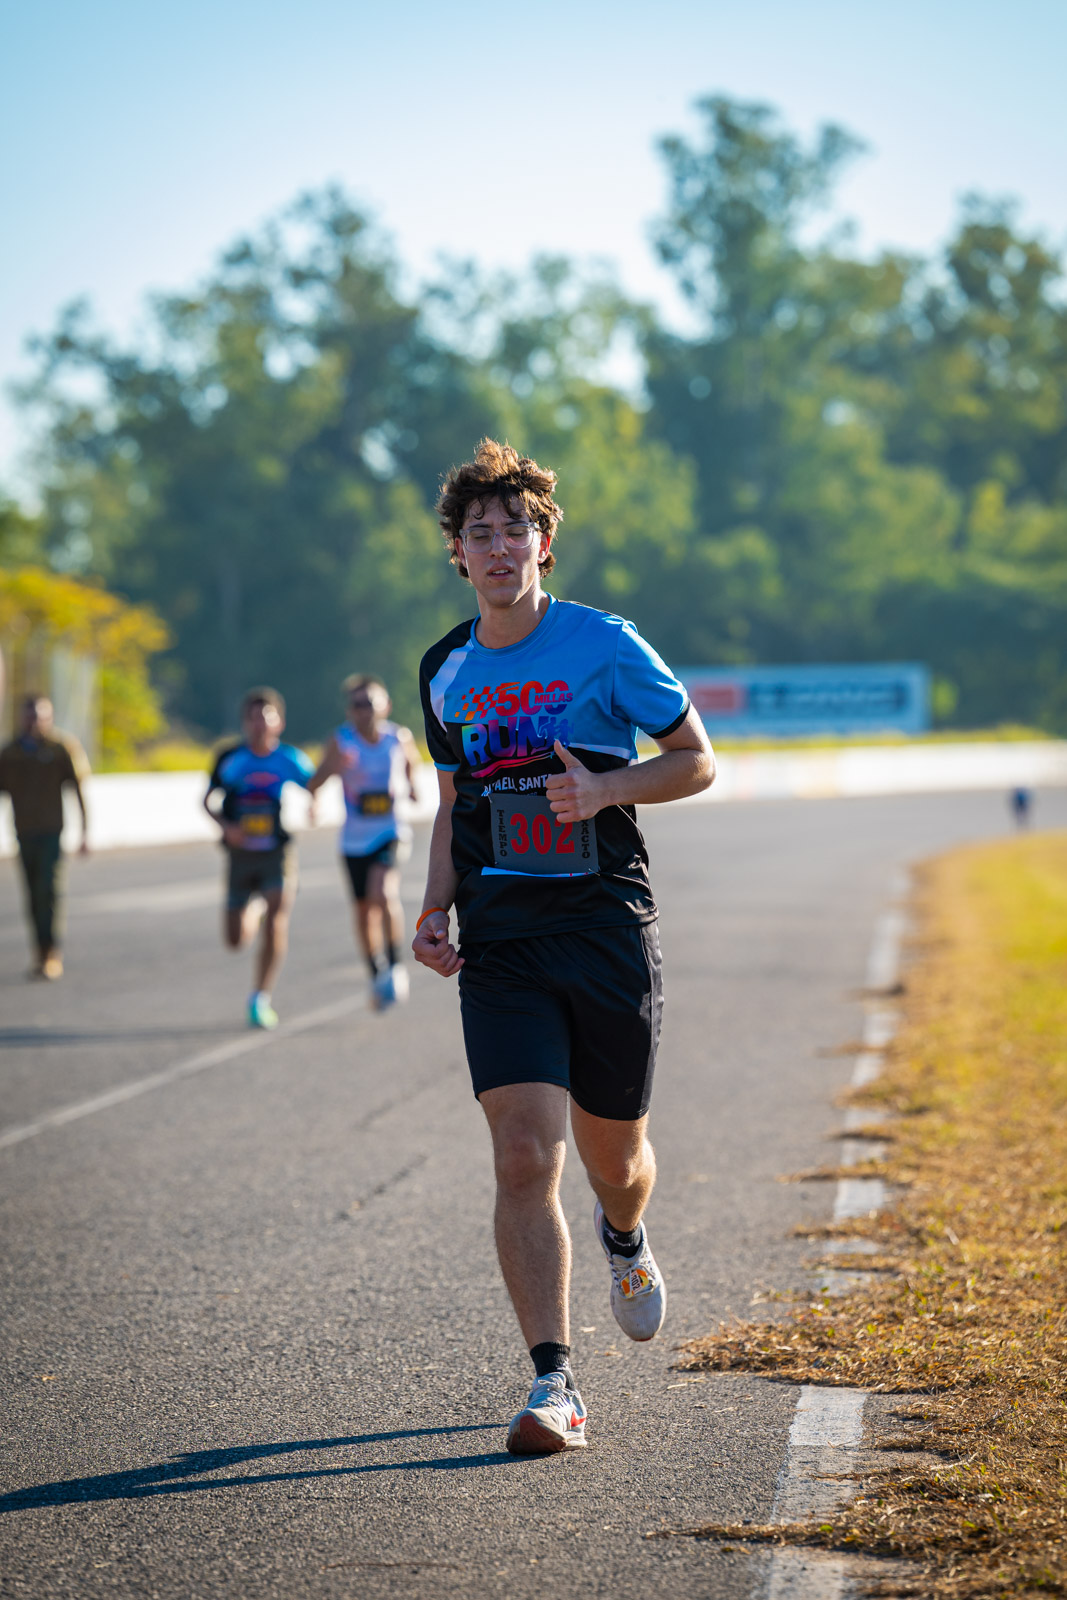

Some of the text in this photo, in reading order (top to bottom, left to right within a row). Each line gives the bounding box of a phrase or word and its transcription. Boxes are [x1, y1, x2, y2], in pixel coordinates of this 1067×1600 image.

[495, 680, 570, 716] 500
[534, 692, 574, 704] MILLAS
[461, 717, 552, 767] RUN
[519, 773, 552, 791] SANT
[497, 809, 508, 857] TIEMPO
[510, 813, 575, 855] 302
[581, 819, 592, 859] XACTO
[632, 1274, 641, 1291] 302
